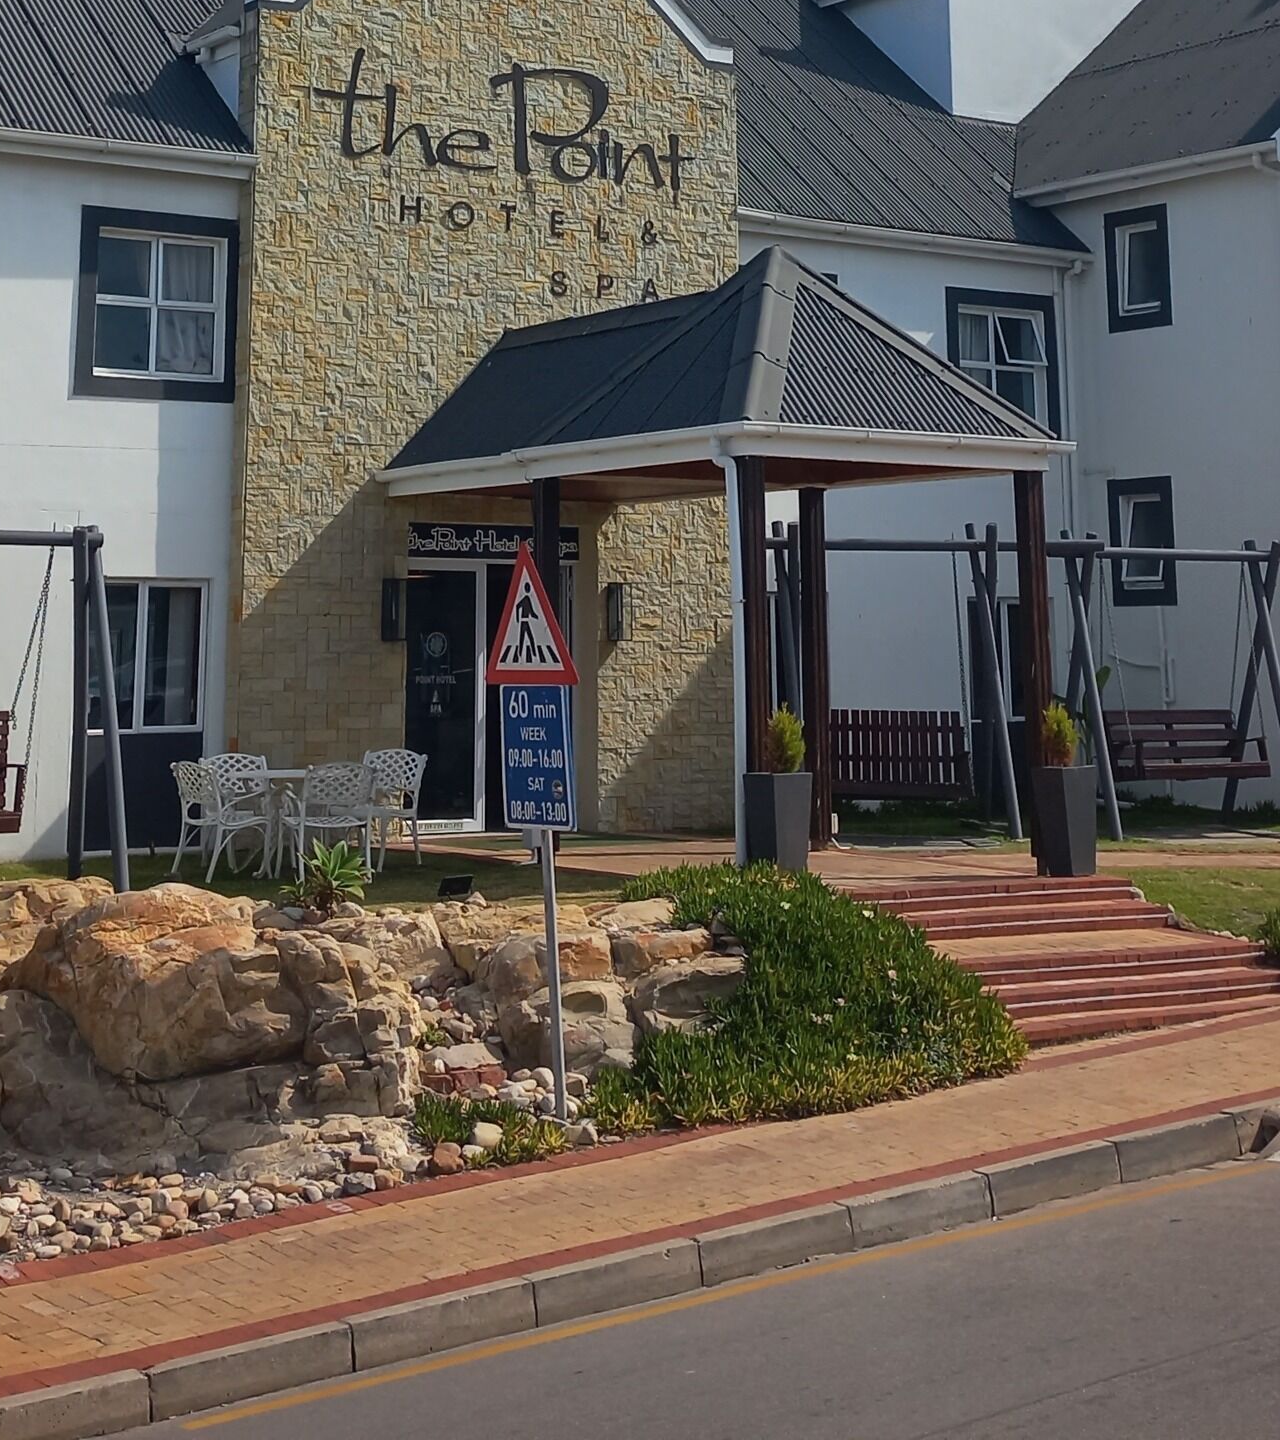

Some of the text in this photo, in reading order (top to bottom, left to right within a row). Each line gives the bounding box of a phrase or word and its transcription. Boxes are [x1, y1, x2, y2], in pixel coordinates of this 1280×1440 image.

[314, 47, 696, 192] the Point
[399, 194, 658, 245] HOTEL &
[551, 270, 660, 303] SPA
[431, 526, 472, 552] Point
[559, 536, 578, 557] pa
[508, 690, 557, 719] 60 min
[520, 726, 547, 742] WEEK
[508, 748, 564, 769] 09:00-16:00
[527, 777, 545, 791] SAT
[510, 800, 567, 822] 08:00-13:00
